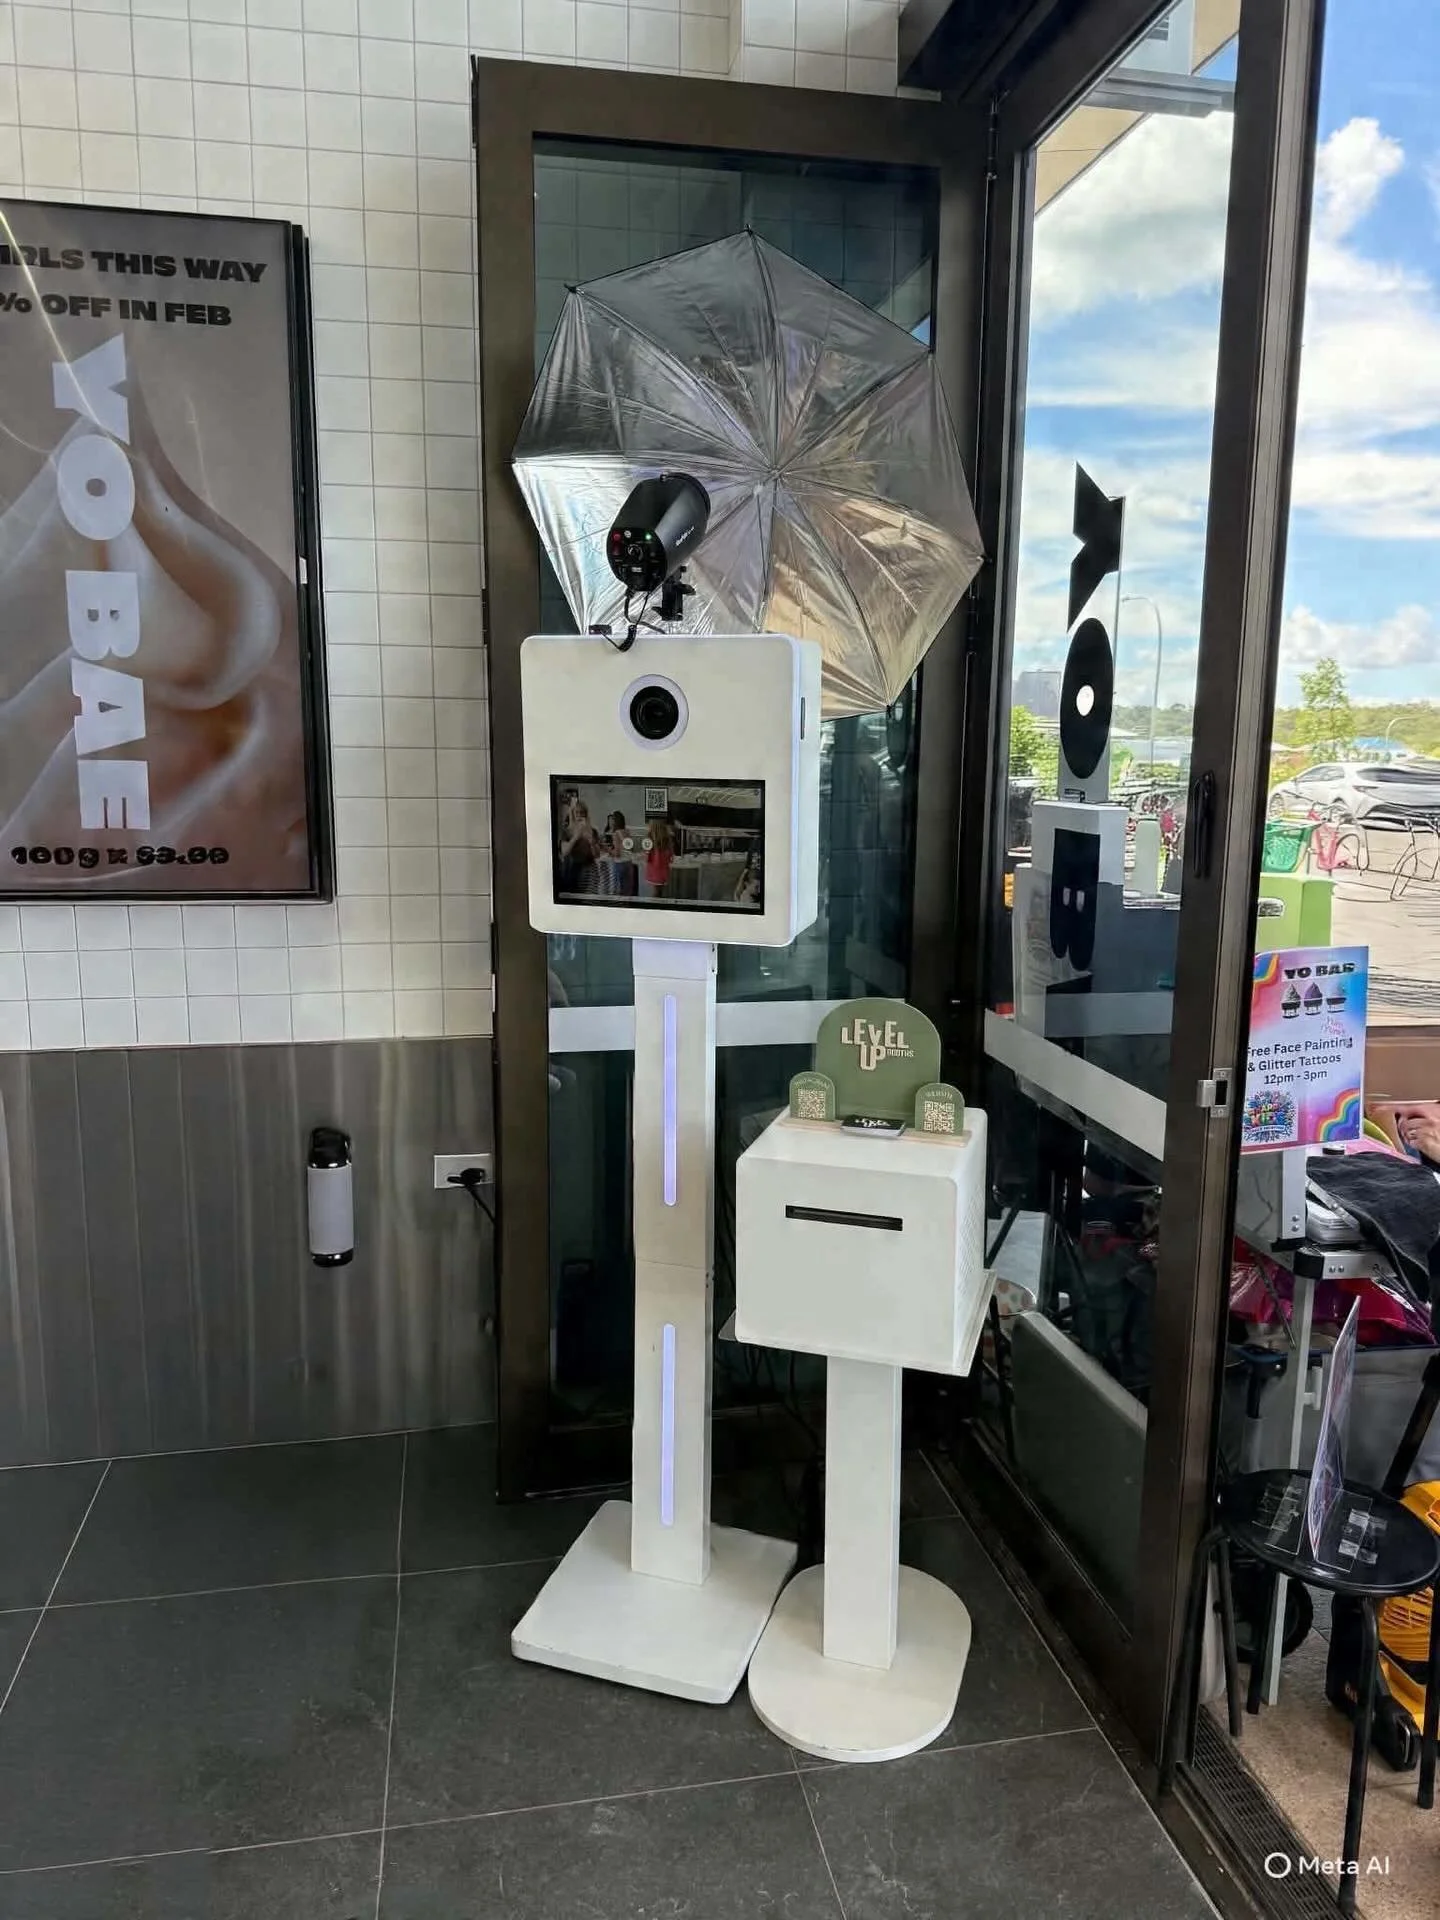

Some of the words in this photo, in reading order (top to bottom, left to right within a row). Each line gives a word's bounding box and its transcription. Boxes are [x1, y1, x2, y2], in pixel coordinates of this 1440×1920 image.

[91, 250, 177, 277] THIS
[184, 257, 267, 283] WAY
[41, 294, 111, 318] OFF
[119, 299, 156, 321] IN
[165, 302, 232, 326] FEB
[65, 569, 150, 830] BAE
[1284, 967, 1311, 979] YO
[841, 1018, 909, 1049] LEVEL
[1274, 1043, 1302, 1055] Face
[1304, 1037, 1353, 1051] Painting
[860, 1044, 886, 1071] UP
[1247, 1062, 1256, 1072] &
[1258, 1059, 1297, 1072] Glitter
[1298, 1054, 1342, 1067] Tattoos
[1263, 1074, 1294, 1086] 12pm
[1303, 1070, 1328, 1082] 3pm
